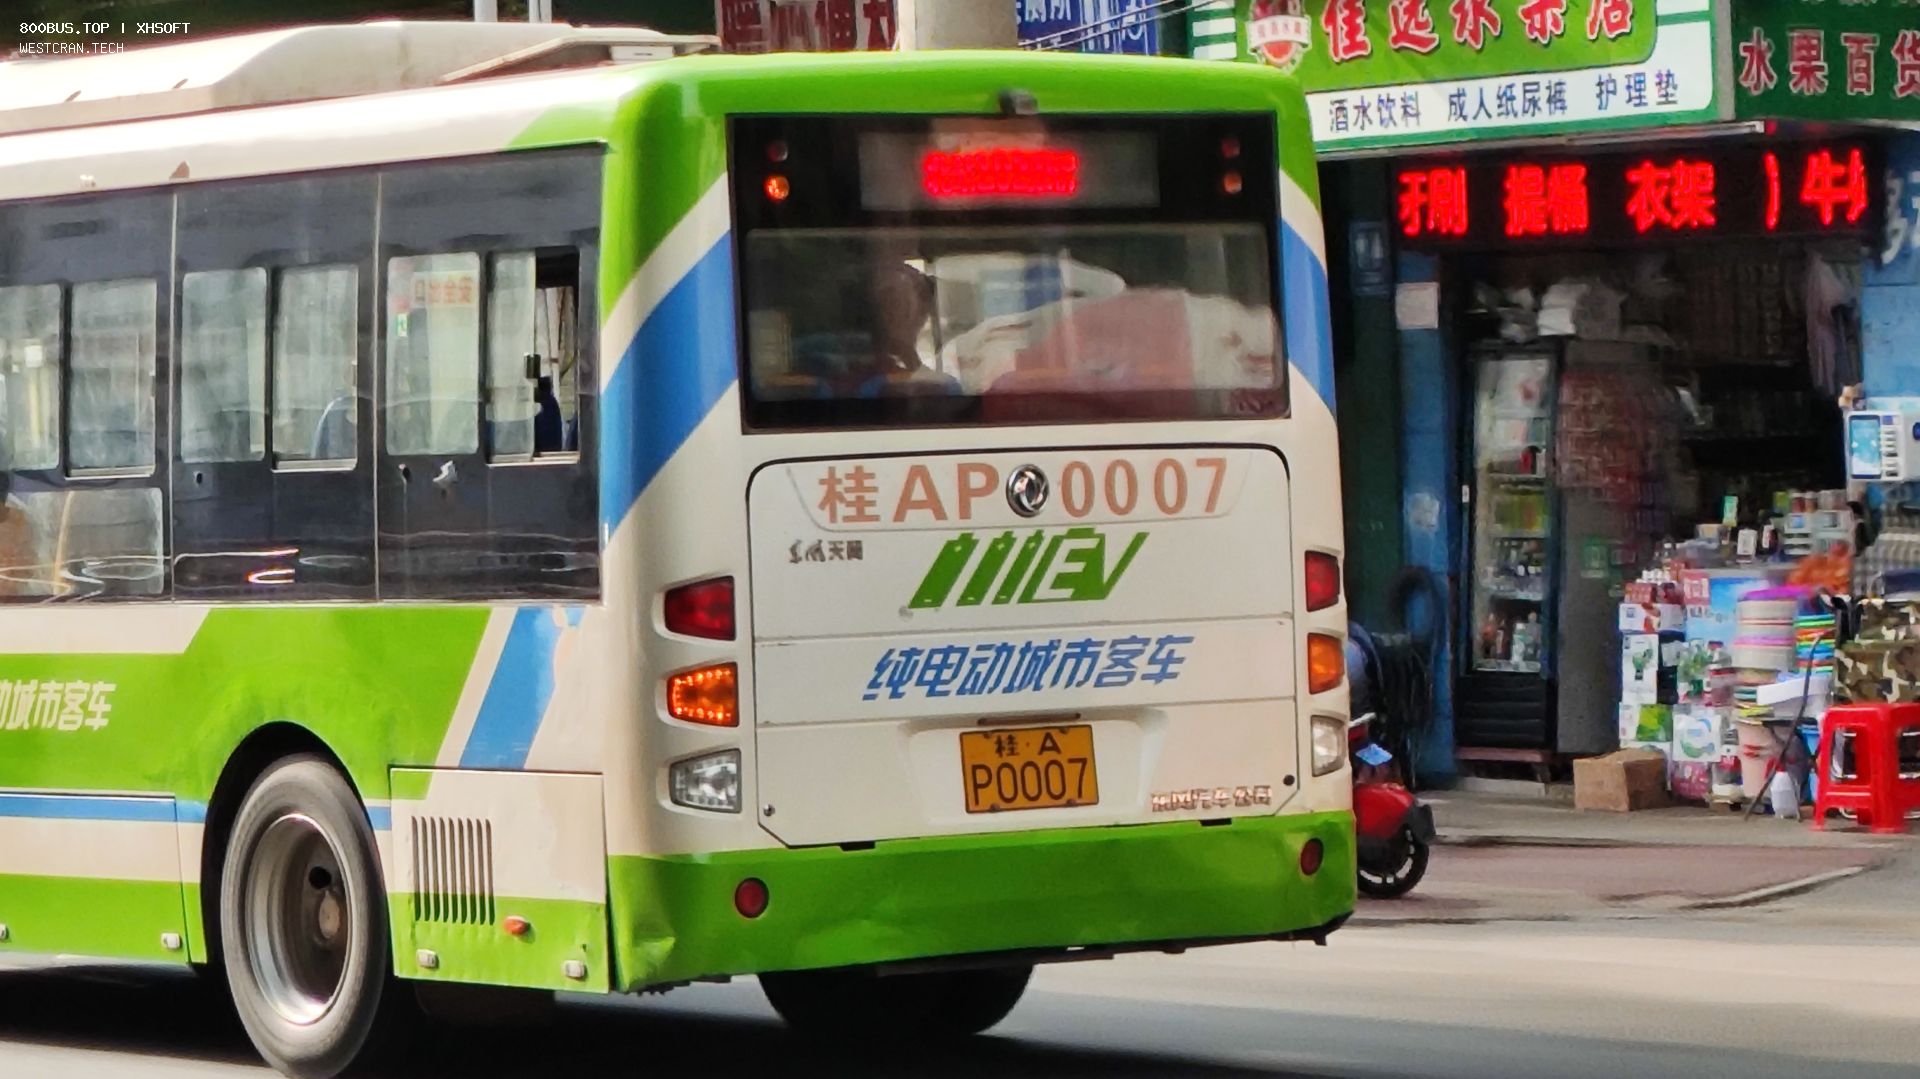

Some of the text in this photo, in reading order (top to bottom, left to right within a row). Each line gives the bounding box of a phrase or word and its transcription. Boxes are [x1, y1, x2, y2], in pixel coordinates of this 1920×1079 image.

[1738, 27, 1920, 98] 水果百货
[1330, 69, 1679, 133] 酒水饮料 成人纸尿裤 护理垫
[1625, 158, 1717, 234] 衣架
[863, 634, 1195, 701] 纯电动城市客车
[971, 757, 1088, 806] P0007
